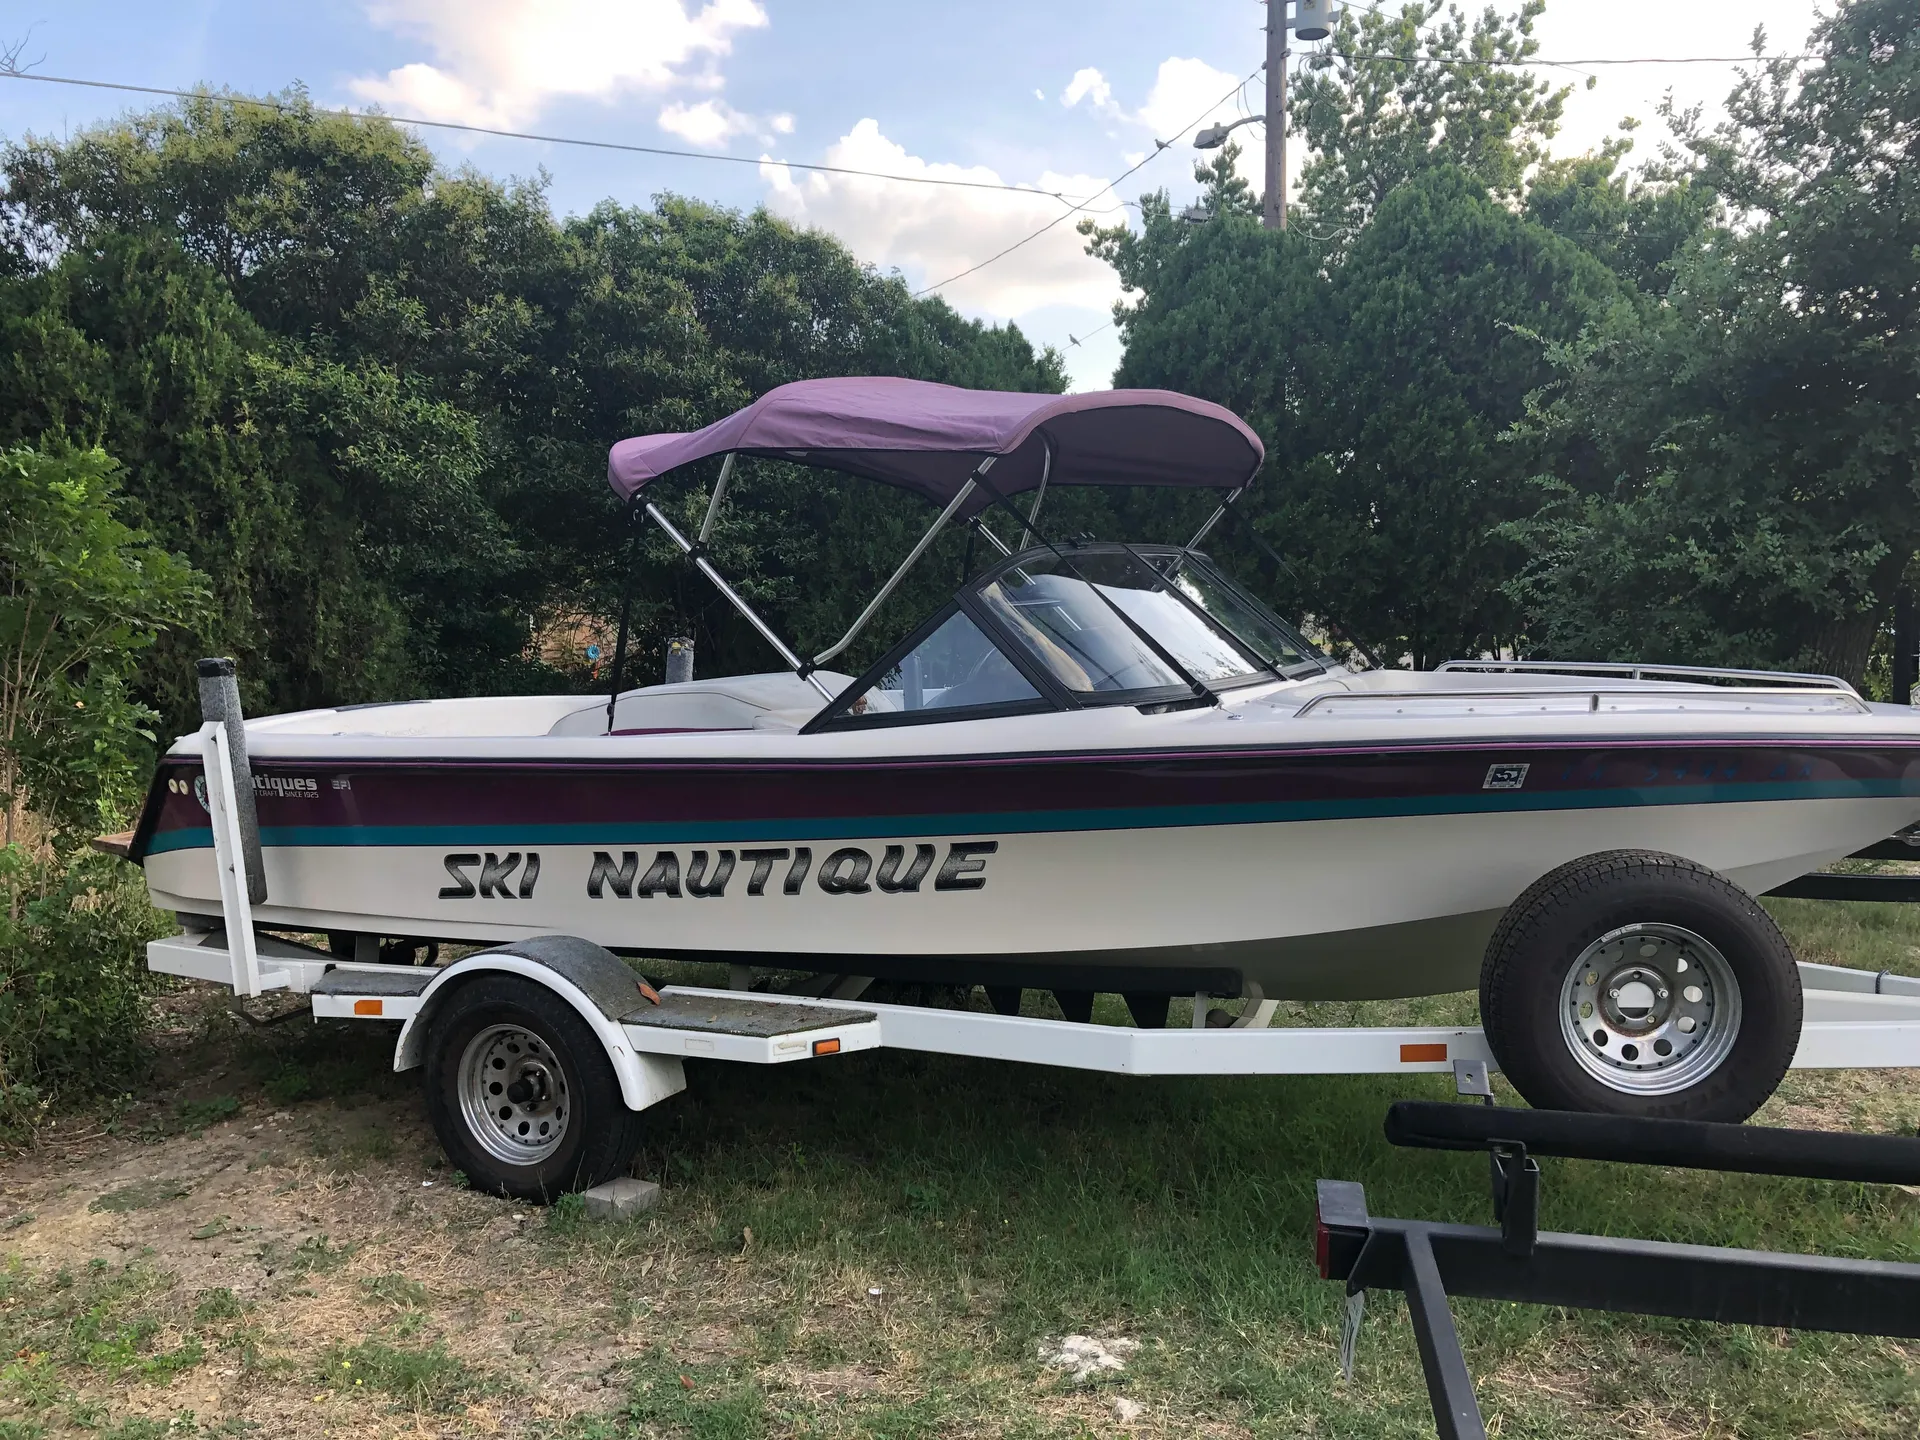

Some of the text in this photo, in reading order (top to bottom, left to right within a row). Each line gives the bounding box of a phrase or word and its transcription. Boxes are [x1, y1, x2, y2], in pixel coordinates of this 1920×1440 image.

[259, 789, 279, 797] CRAFT
[284, 790, 303, 798] SINCE
[303, 791, 320, 799] 1925
[438, 840, 999, 899] SKI NAUTIQUE
